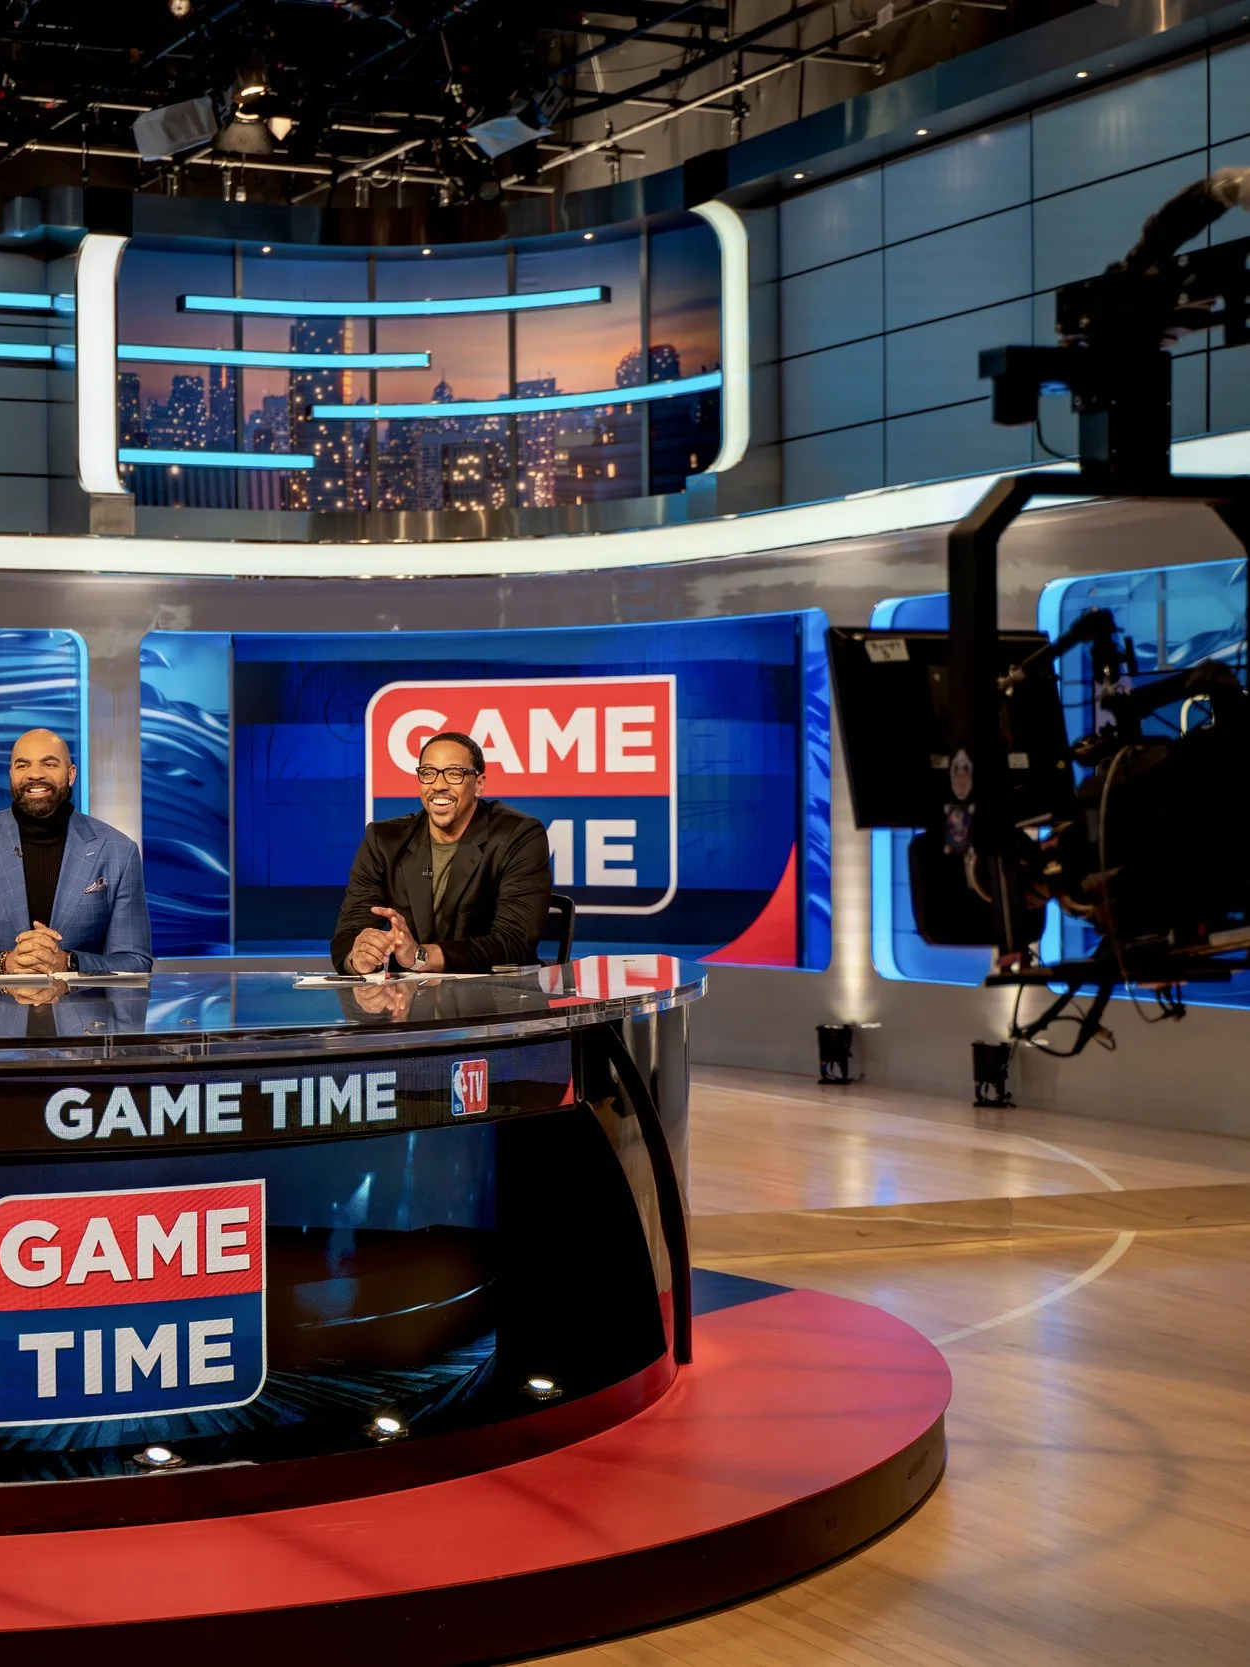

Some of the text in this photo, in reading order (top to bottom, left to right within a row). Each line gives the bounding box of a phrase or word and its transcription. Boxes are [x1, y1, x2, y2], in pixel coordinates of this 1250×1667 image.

[387, 704, 657, 775] GAME
[44, 1071, 398, 1141] GAME TIME
[467, 1070, 484, 1104] TV
[18, 1317, 235, 1398] TIME
